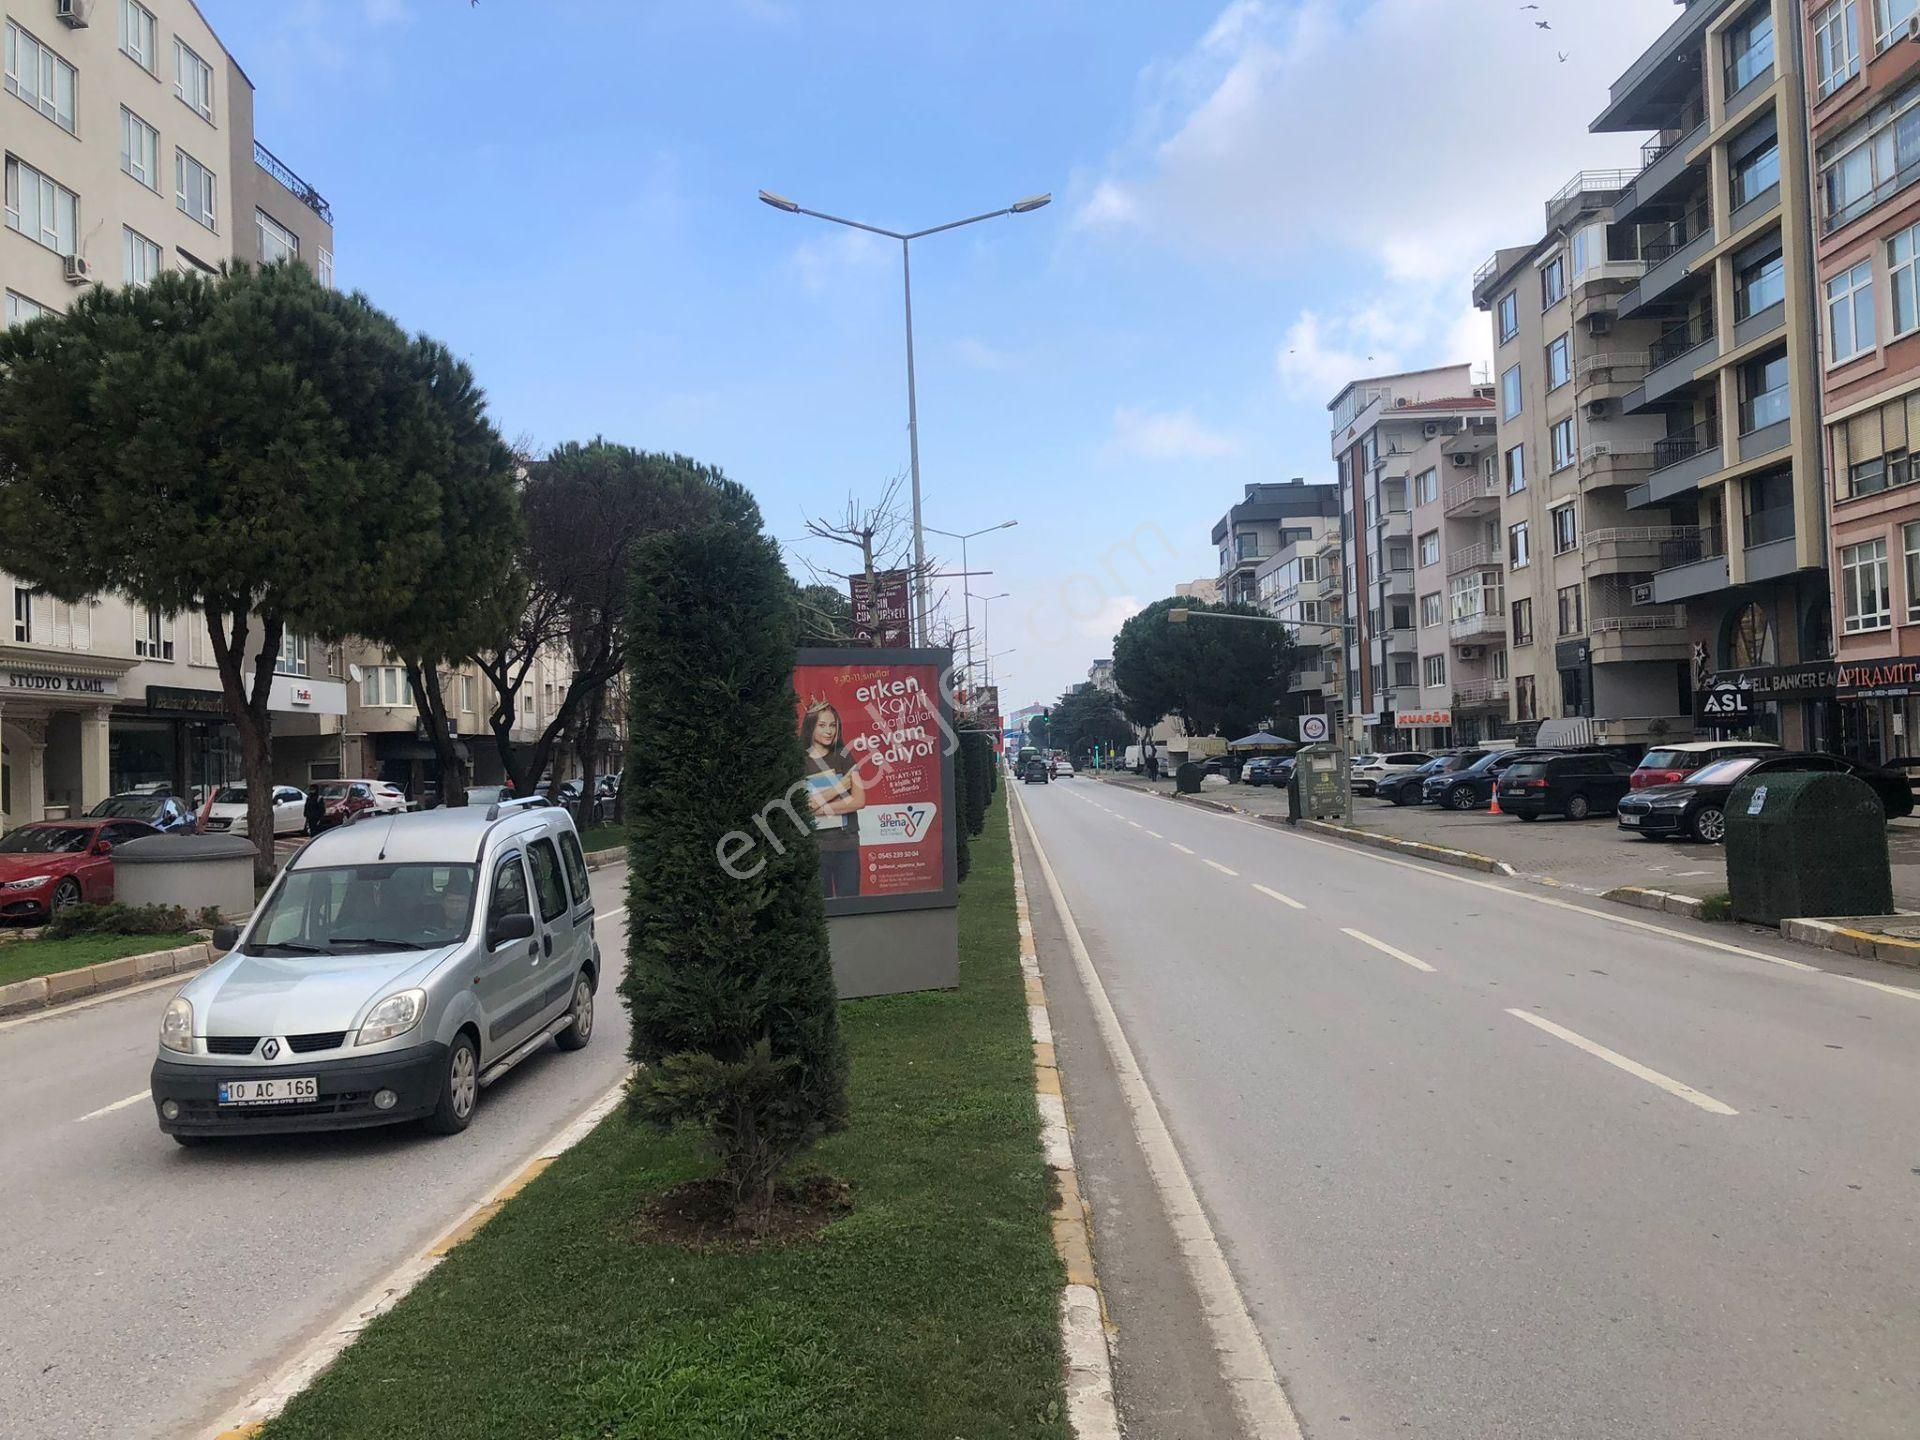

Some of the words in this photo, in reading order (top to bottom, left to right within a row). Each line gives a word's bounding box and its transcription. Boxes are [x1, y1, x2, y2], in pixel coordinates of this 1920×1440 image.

[9, 673, 62, 689] STÜDYO
[1773, 672, 1817, 690] BANKER
[1846, 663, 1917, 687] PİRAMİT
[856, 676, 919, 701] erken
[877, 688, 927, 715] kayıt
[1704, 693, 1748, 712] ASL
[1399, 711, 1450, 724] KUAFÖR
[853, 725, 926, 752] devam
[871, 741, 935, 765] ediyor
[880, 819, 906, 828] arena
[229, 1083, 245, 1098] 10
[256, 1082, 274, 1097] AC
[287, 1080, 314, 1095] 166
